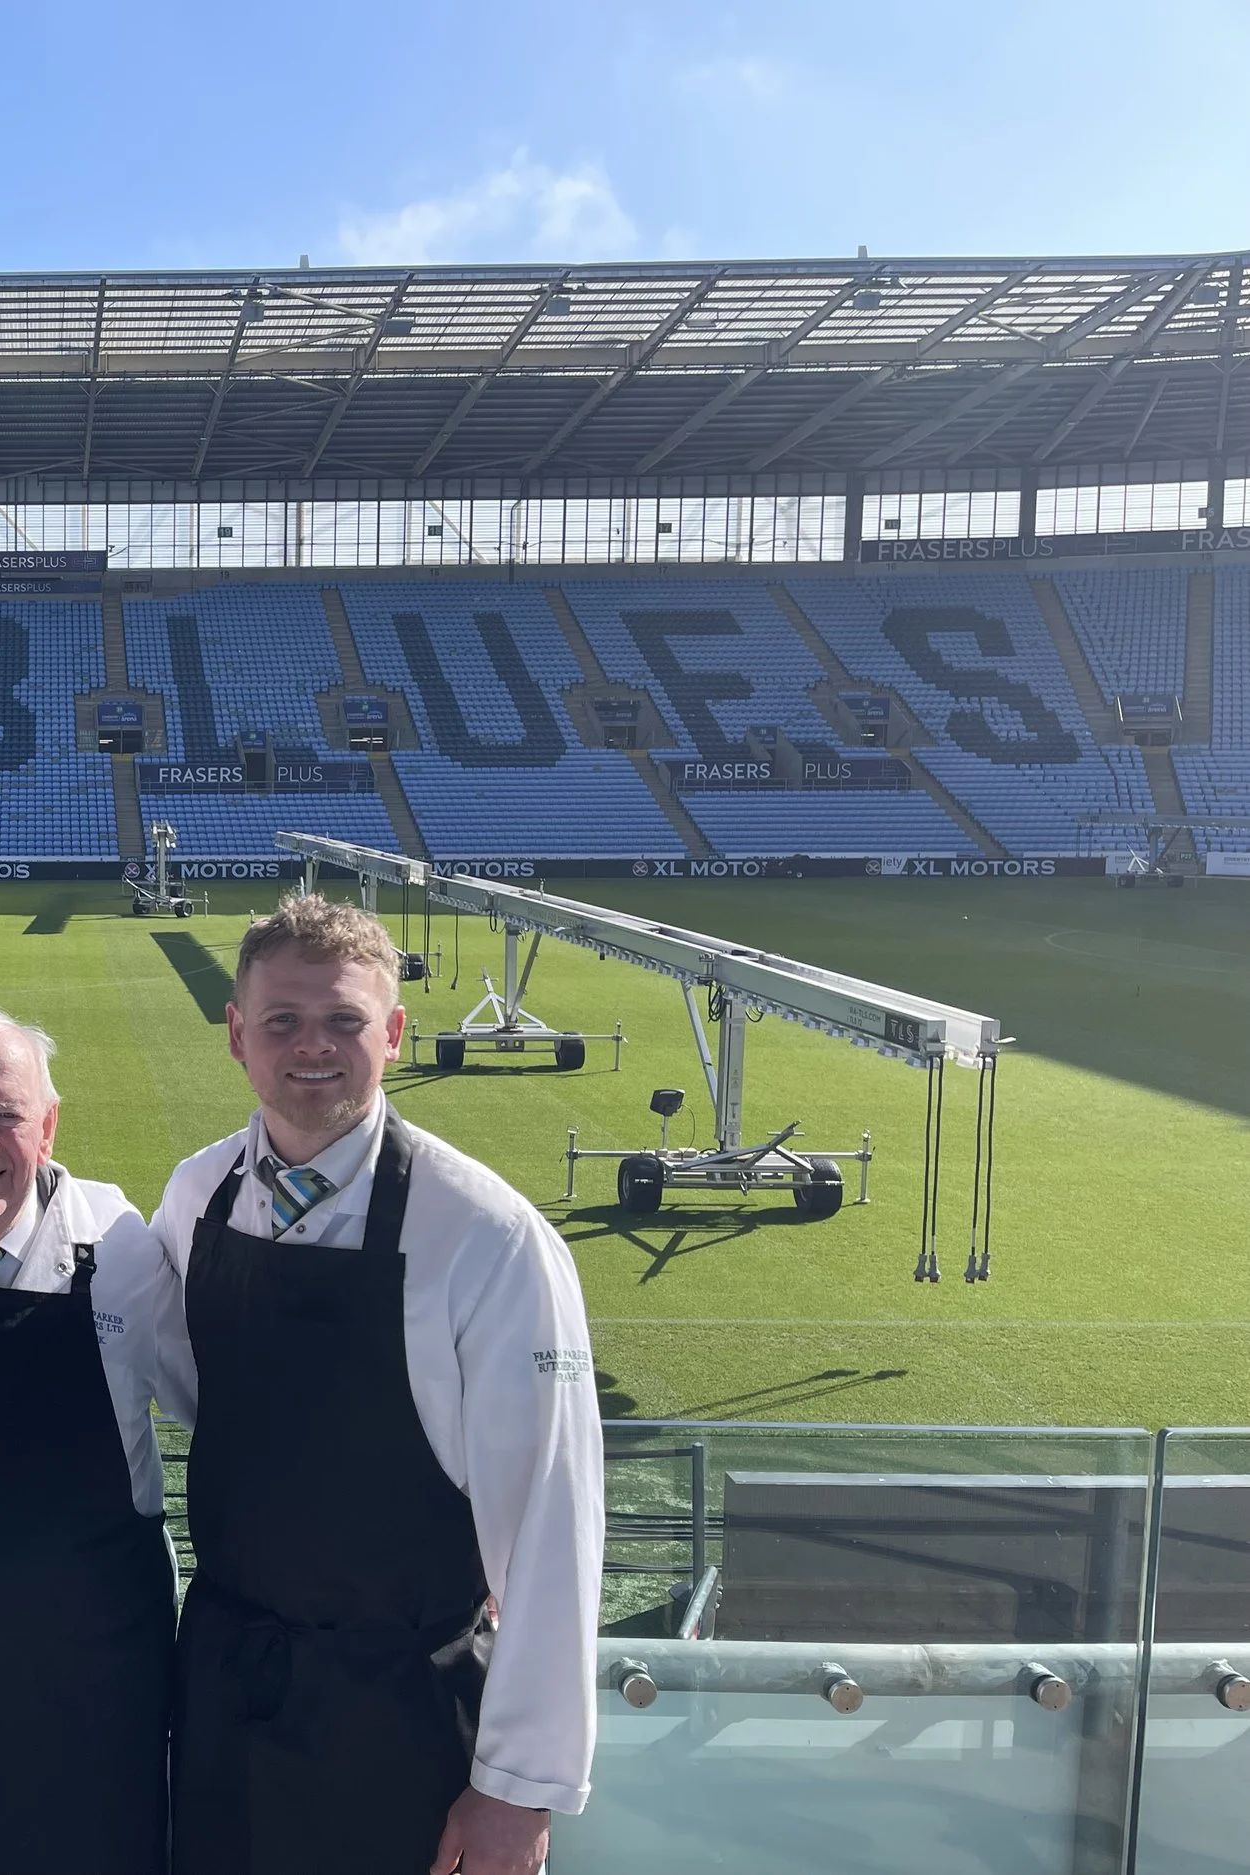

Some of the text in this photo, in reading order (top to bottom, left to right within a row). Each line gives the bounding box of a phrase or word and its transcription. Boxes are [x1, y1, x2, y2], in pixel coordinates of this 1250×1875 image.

[219, 527, 231, 537] 19
[878, 537, 1054, 561] FRASERSPLUS
[220, 571, 230, 579] 19
[159, 766, 323, 783] FRASERS PLUS
[684, 763, 852, 779] FRASERS PLUS
[181, 863, 280, 878] MOTORS
[433, 862, 535, 877] MOTORS
[653, 861, 683, 876] XL
[913, 860, 1056, 876] XL MOTORS
[890, 1019, 914, 1043] TLS
[92, 1310, 125, 1325] PARKER
[107, 1323, 125, 1334] LTD
